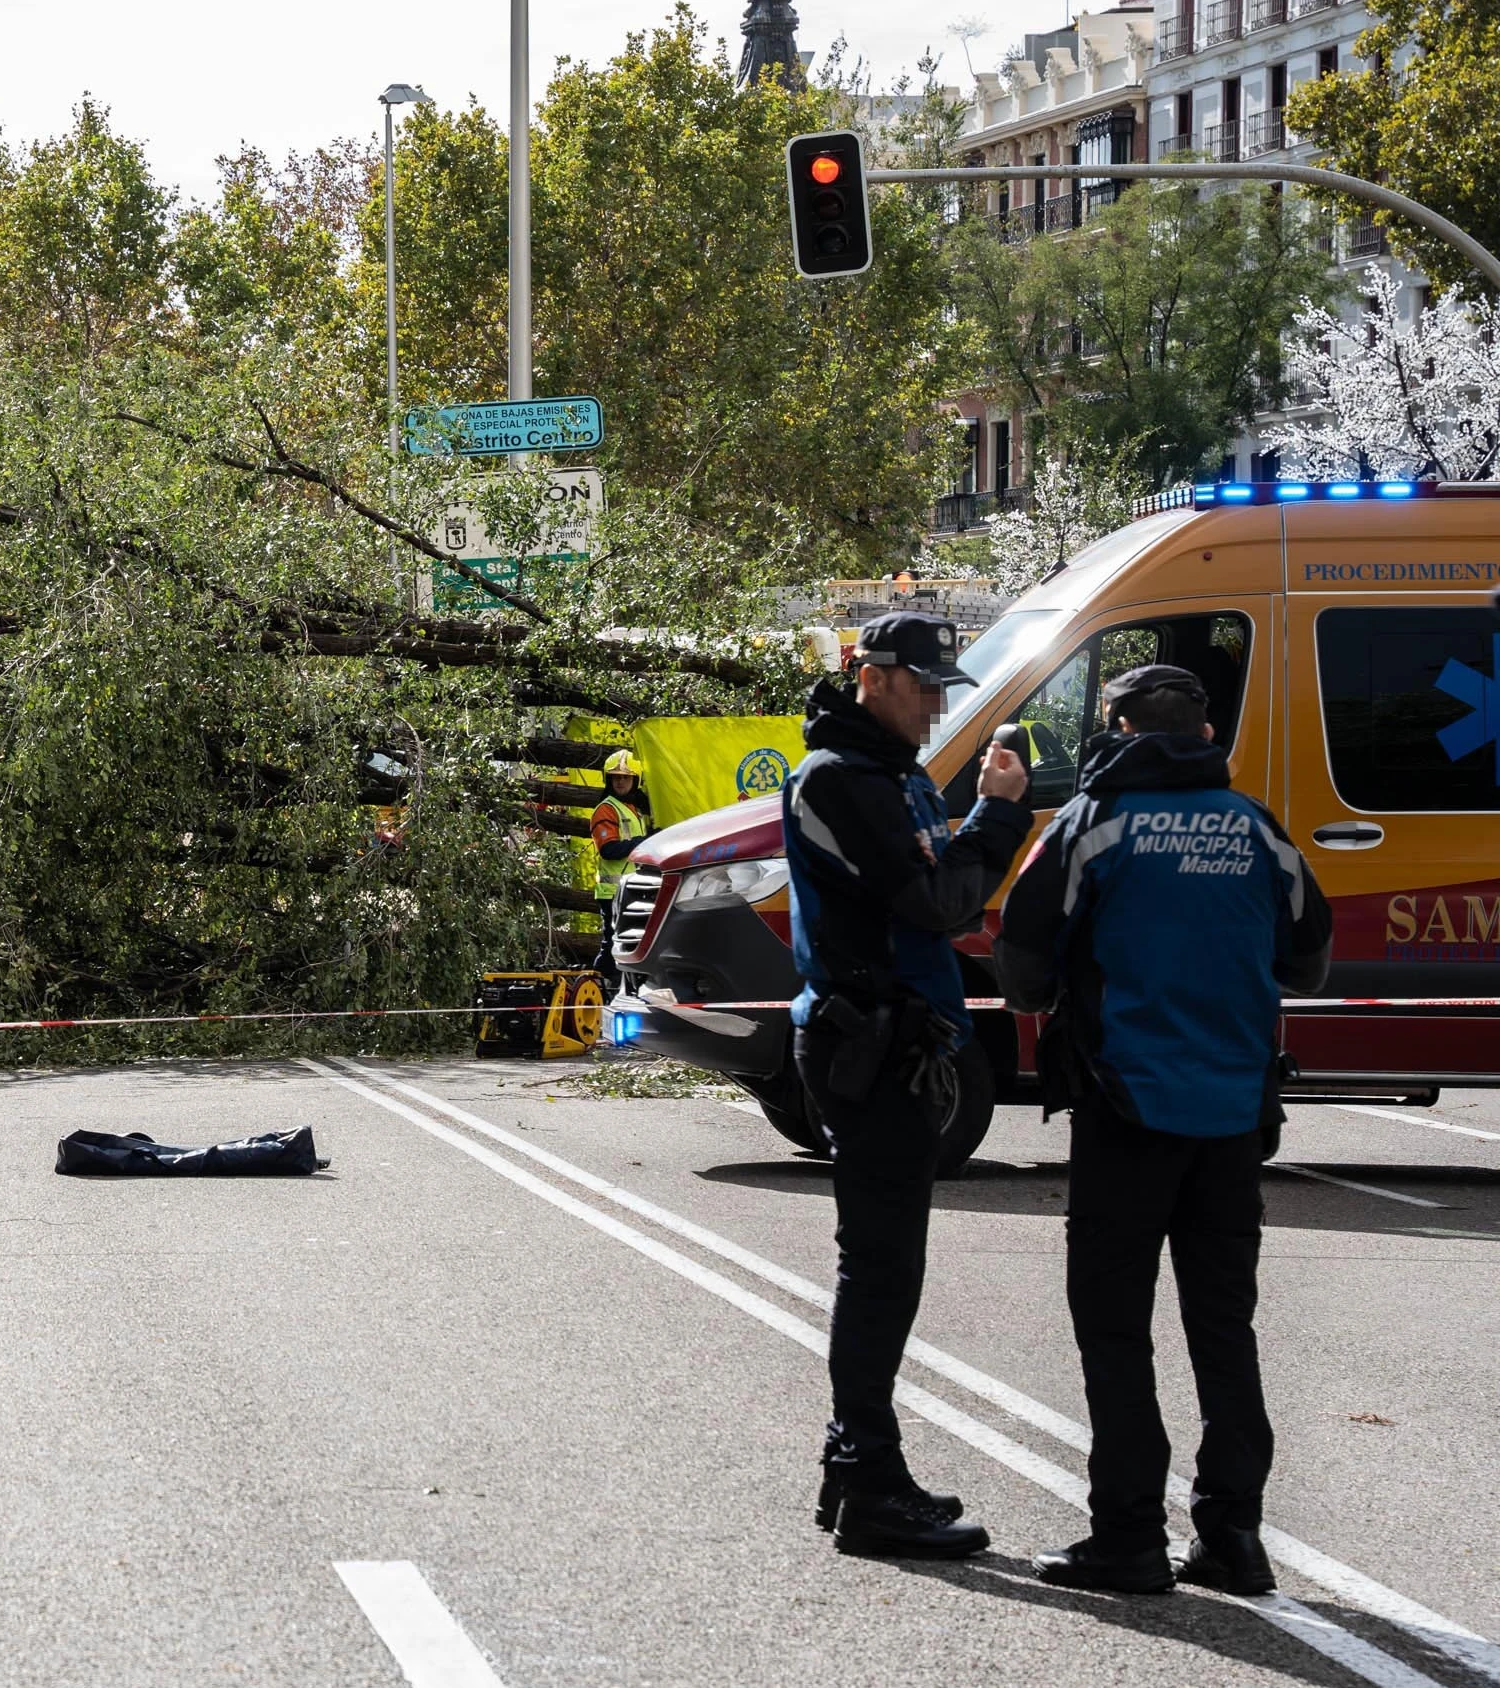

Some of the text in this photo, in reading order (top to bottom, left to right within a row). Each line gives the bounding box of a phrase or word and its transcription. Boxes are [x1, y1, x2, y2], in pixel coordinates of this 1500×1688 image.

[485, 410, 499, 419] DE
[501, 407, 534, 418] BAJAS
[536, 404, 591, 416] EMISINES
[473, 419, 522, 431] ESPECIAL
[524, 414, 589, 428] PROTECCÓN
[527, 430, 594, 446] Cenro
[486, 562, 517, 574] Sta.
[1304, 563, 1500, 581] PROCEDIMIENT
[1130, 809, 1251, 836] POLICÍA
[1133, 835, 1255, 856] MUNICIPAL
[1177, 854, 1253, 876] Madrid
[1385, 894, 1500, 944] SAM
